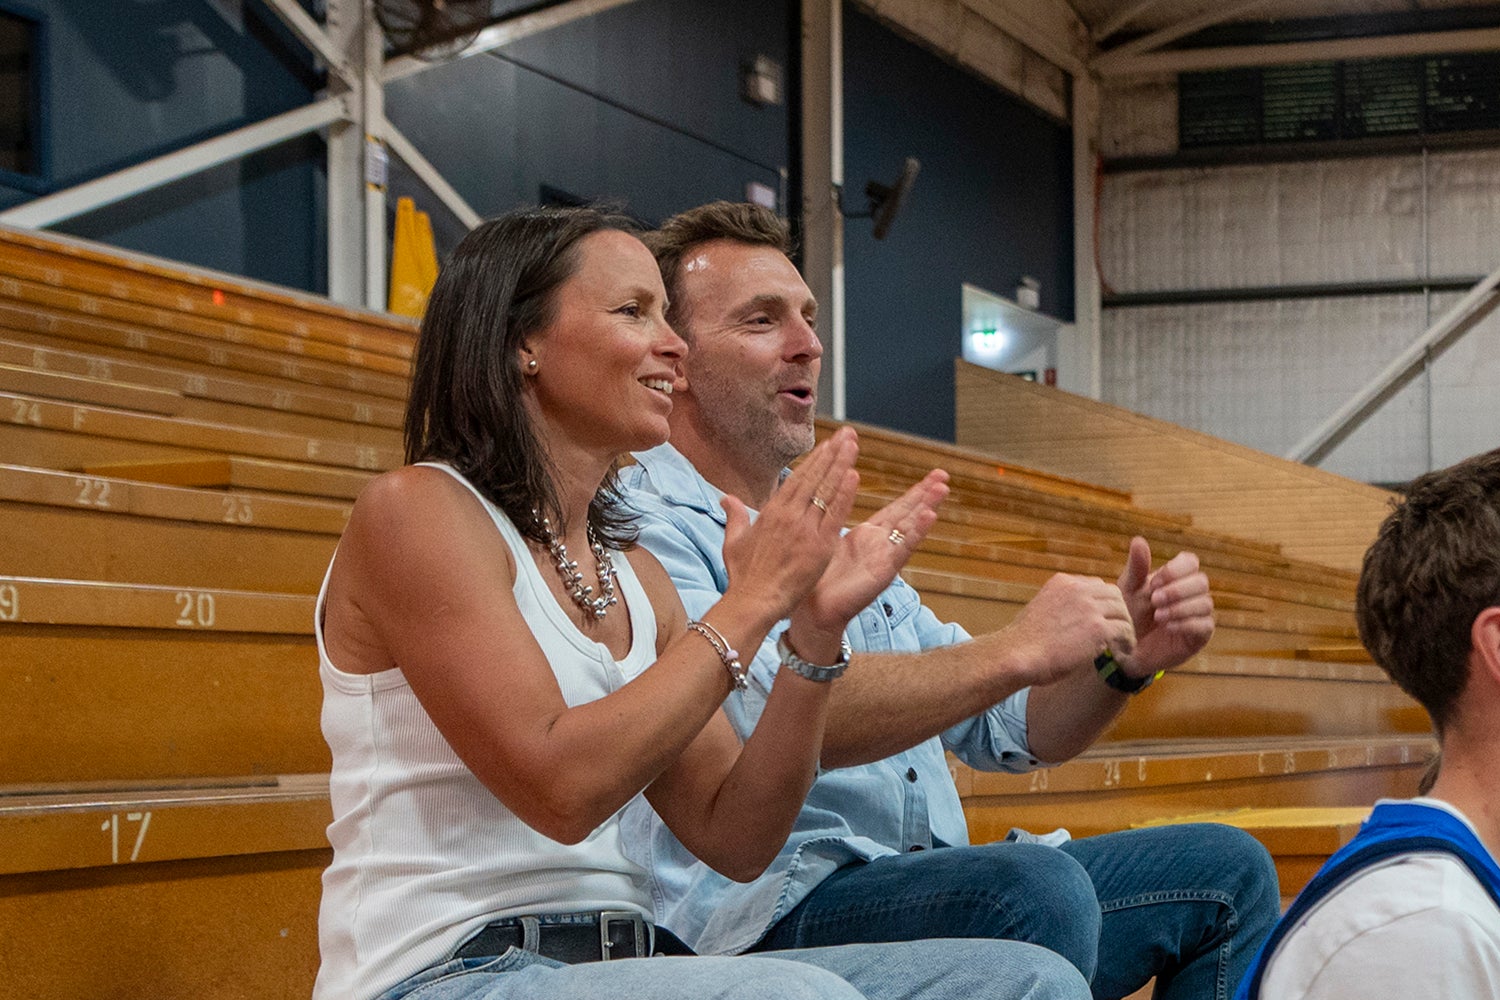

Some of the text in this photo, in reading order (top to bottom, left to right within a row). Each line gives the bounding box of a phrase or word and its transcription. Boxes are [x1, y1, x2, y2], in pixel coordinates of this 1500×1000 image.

[12, 399, 42, 425] 24
[75, 478, 111, 507] 22
[175, 591, 215, 627] 20
[1104, 760, 1121, 786] 24
[101, 811, 151, 864] 17
